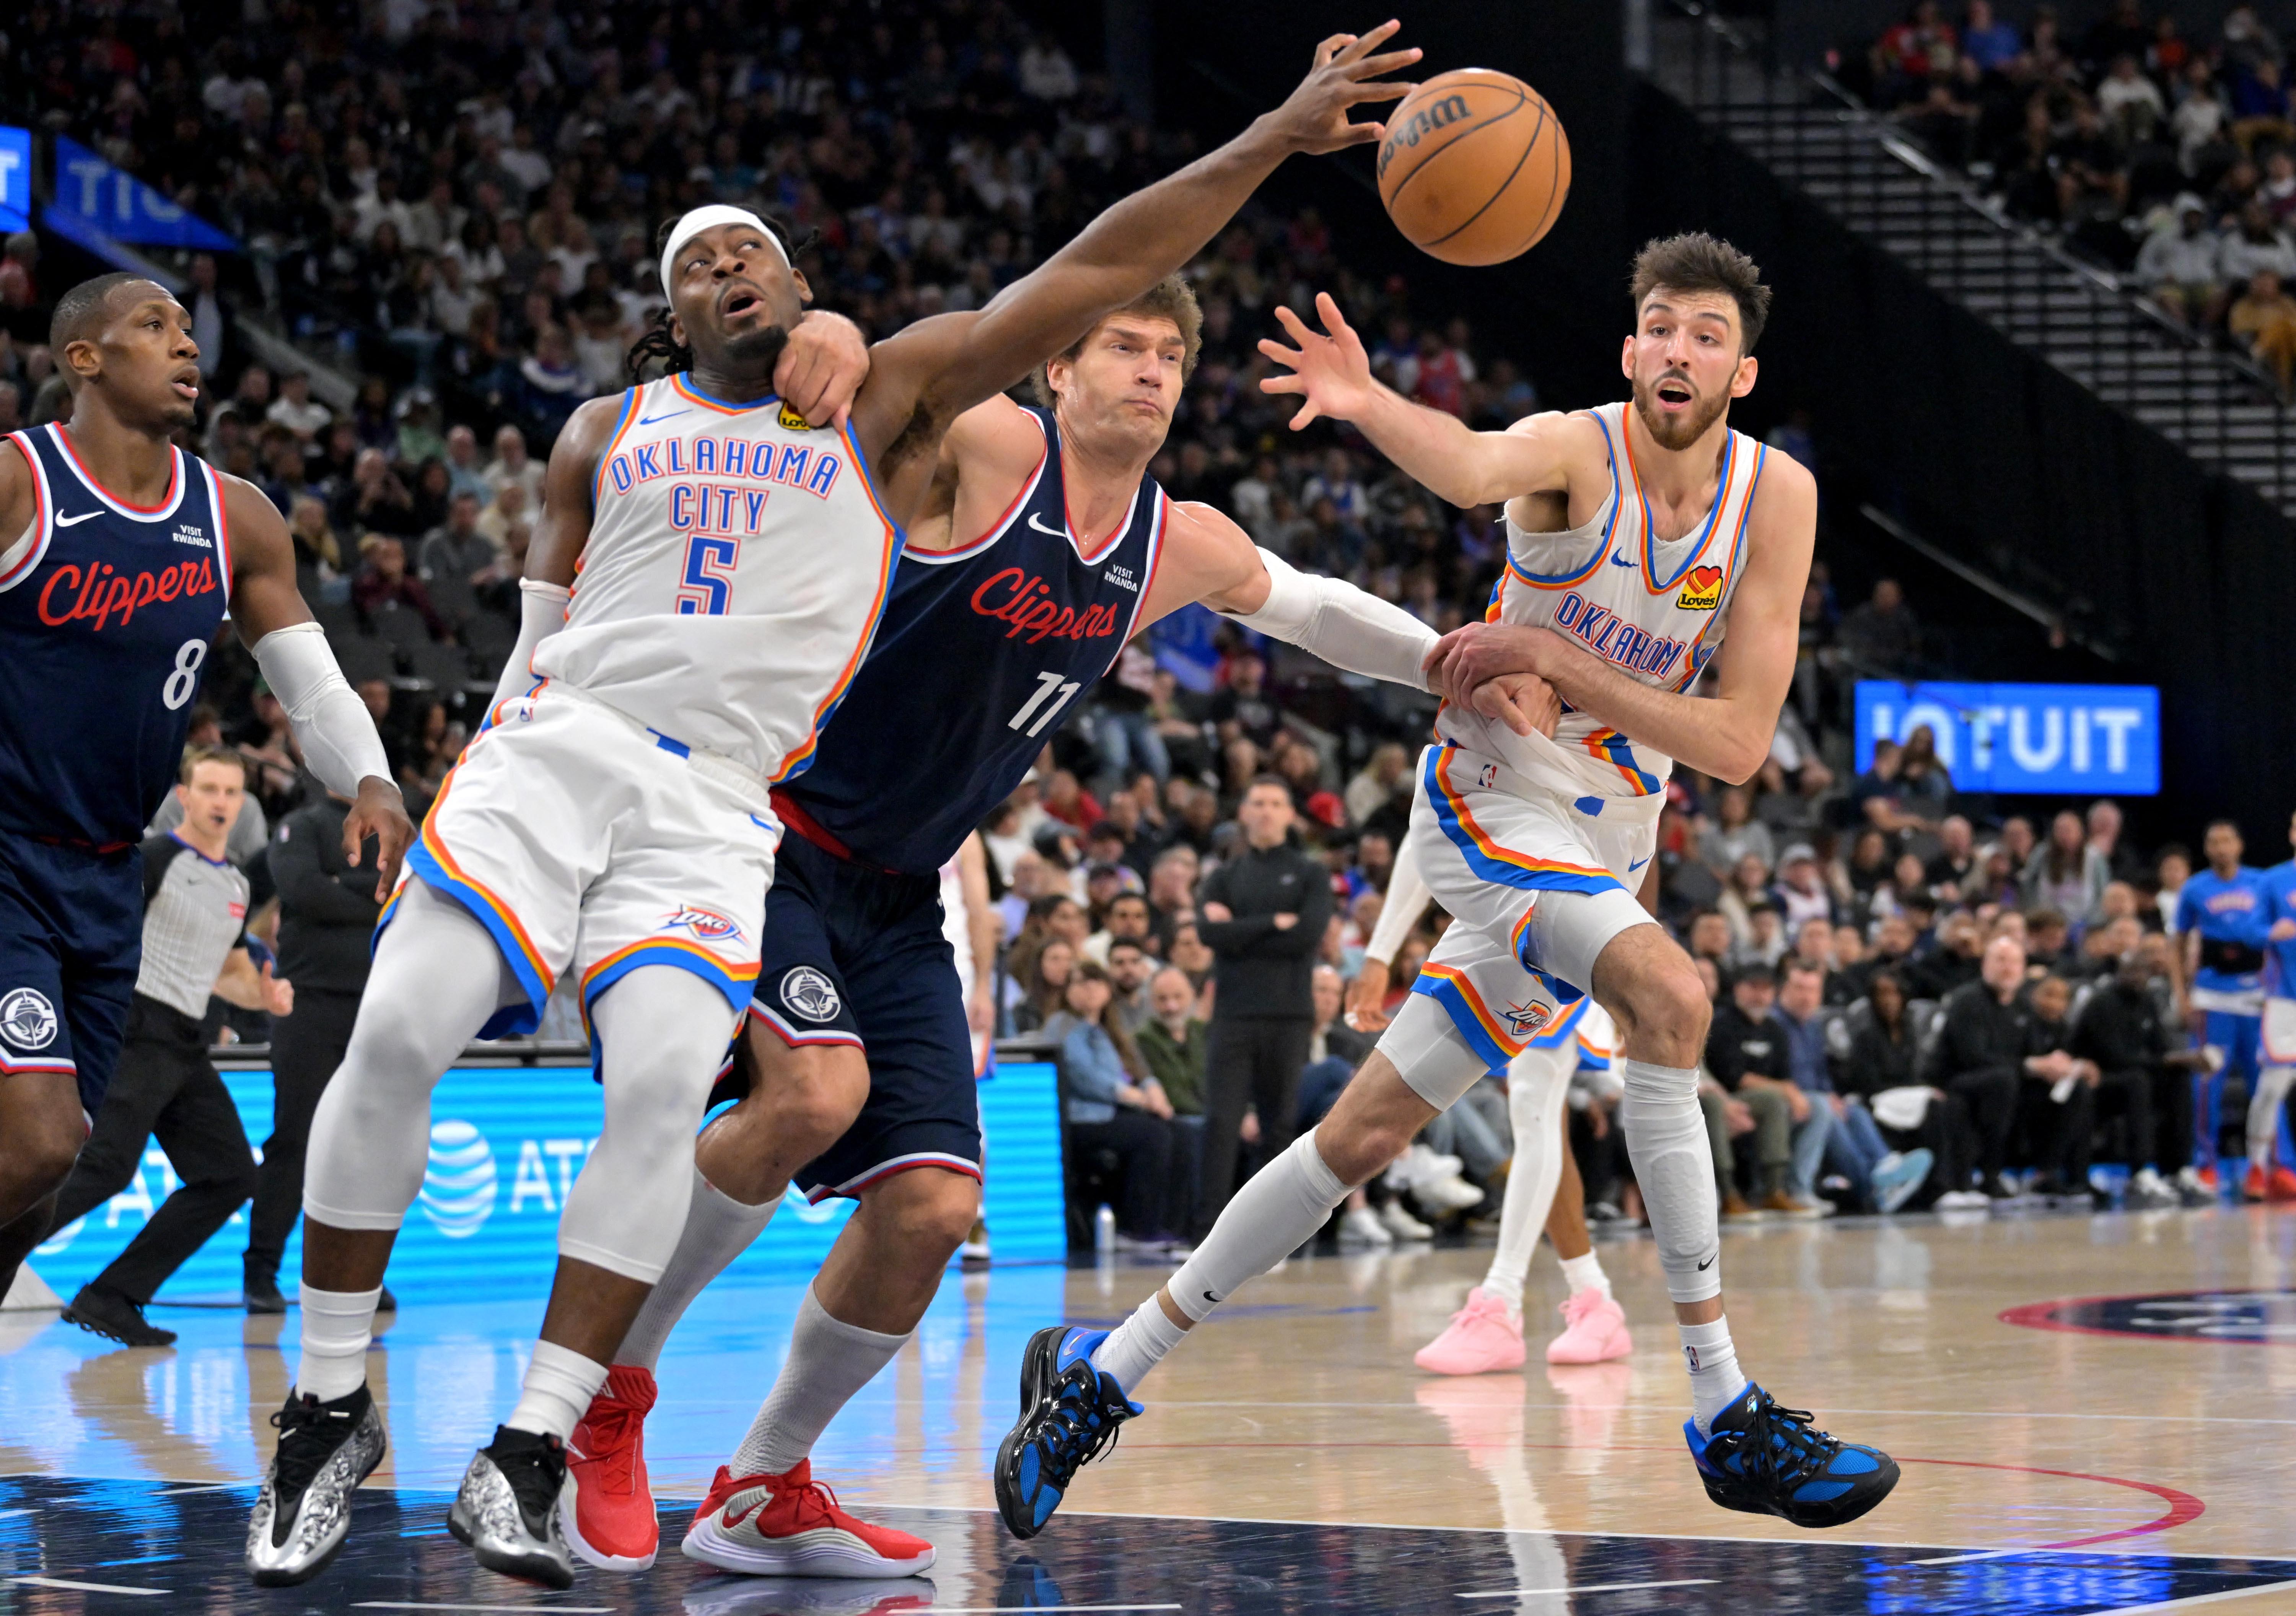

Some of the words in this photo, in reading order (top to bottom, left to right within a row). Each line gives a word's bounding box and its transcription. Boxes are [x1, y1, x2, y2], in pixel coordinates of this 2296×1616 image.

[609, 436, 842, 500] OKLAHOMA
[172, 532, 213, 548] RWANDA
[179, 524, 202, 537] VISIT
[669, 482, 769, 535] CITY
[38, 556, 217, 631] Clippers
[675, 532, 741, 616] 5
[1104, 571, 1138, 592] RWANDA
[1113, 564, 1133, 579] VISIT
[970, 567, 1118, 644] Clippers
[1554, 591, 1686, 680] OKLAHOM
[163, 638, 208, 710] 8
[1008, 671, 1081, 738] 11
[510, 1138, 599, 1213] AT
